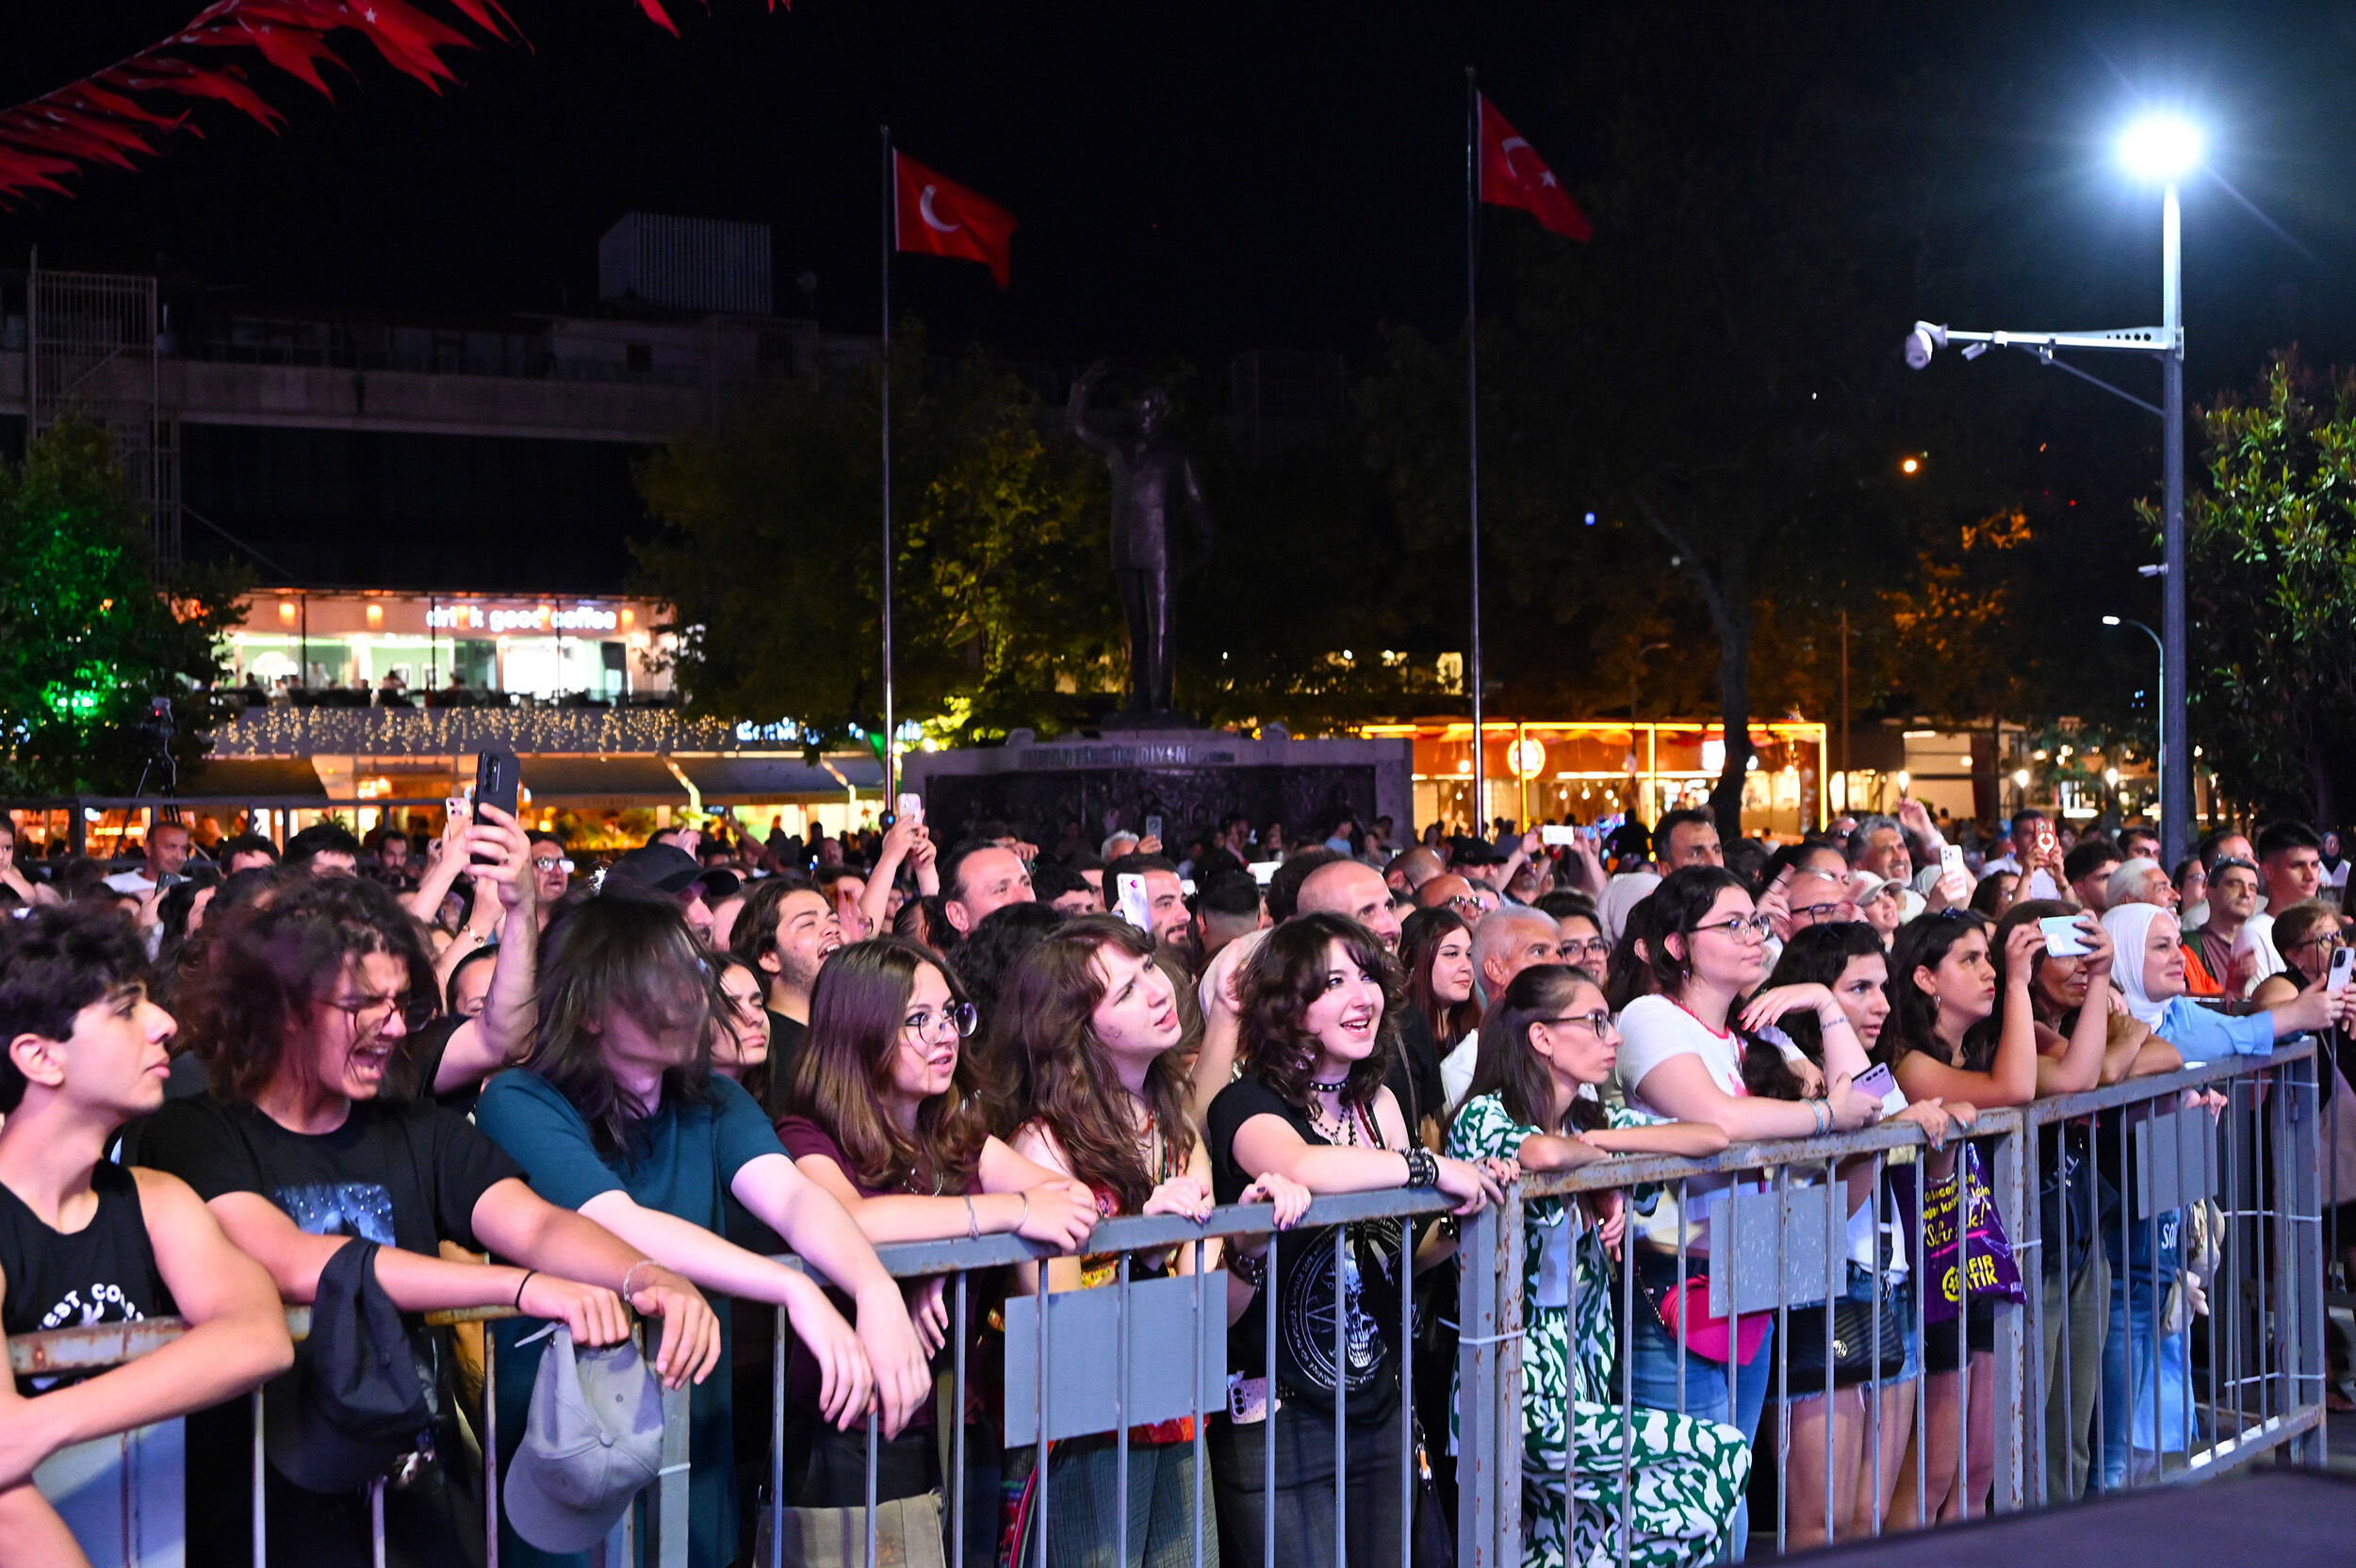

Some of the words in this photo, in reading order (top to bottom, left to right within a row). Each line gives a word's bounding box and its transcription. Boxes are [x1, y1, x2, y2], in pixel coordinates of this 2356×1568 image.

[426, 605, 484, 628] drik
[550, 606, 616, 629] coffee
[38, 1289, 81, 1331] EST
